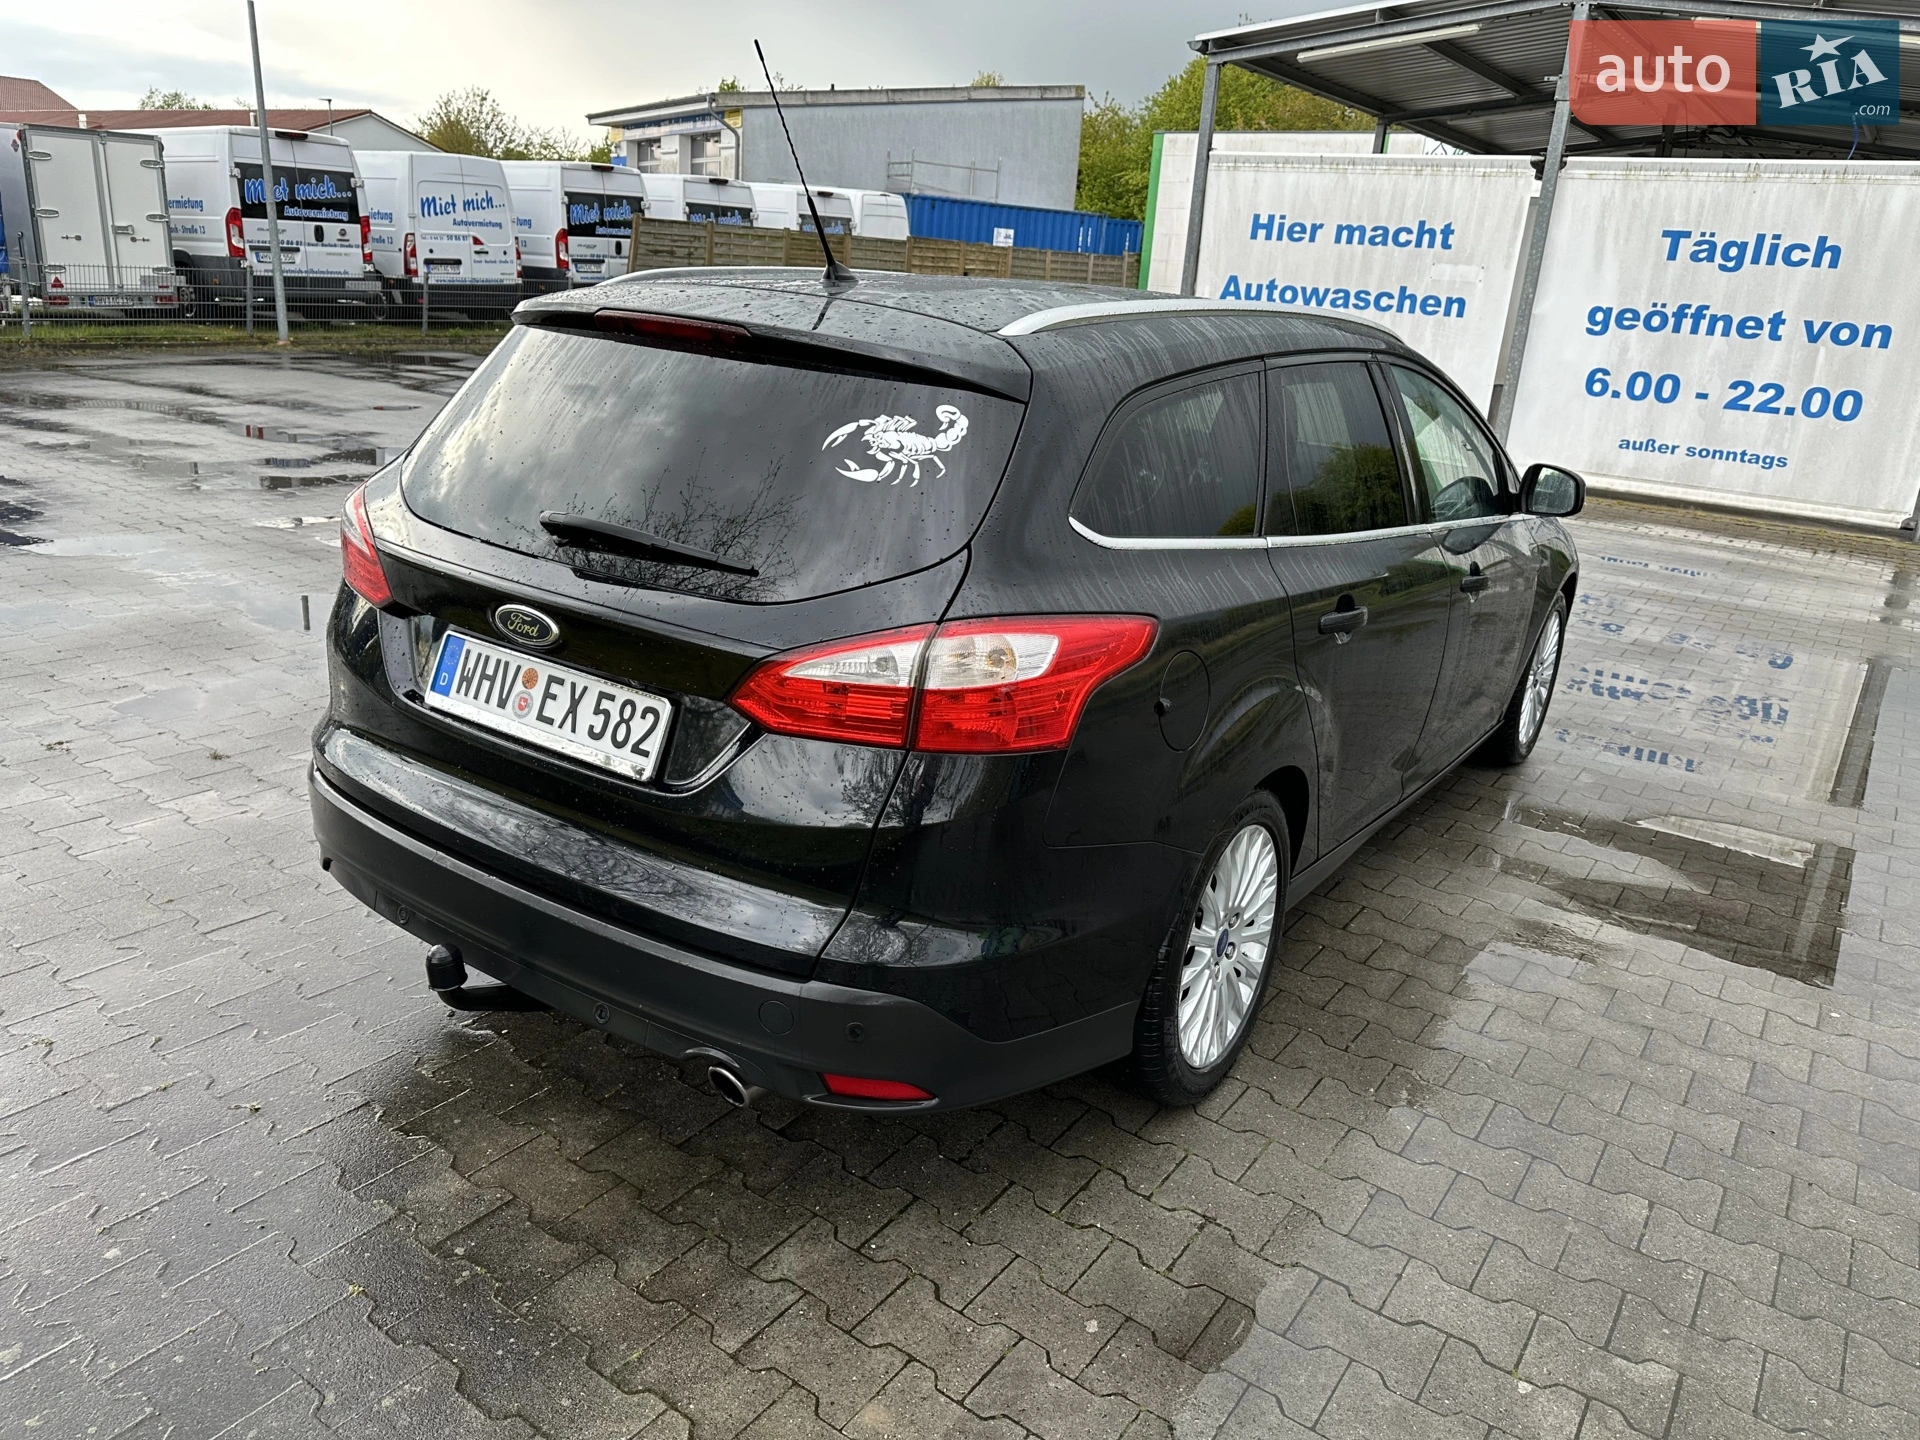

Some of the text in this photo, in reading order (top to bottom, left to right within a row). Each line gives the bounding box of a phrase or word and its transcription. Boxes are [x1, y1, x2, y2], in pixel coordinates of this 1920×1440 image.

[169, 194, 204, 212] ermietung
[245, 176, 289, 204] Met
[284, 205, 349, 221] Autovermietung
[369, 207, 393, 223] ietung
[420, 193, 457, 218] Miet
[570, 202, 600, 226] Miet
[452, 217, 503, 230] Autovermietung
[1250, 213, 1455, 250] Hier macht
[1661, 229, 1843, 273] Täglich
[1219, 275, 1467, 318] Autowaschen
[1585, 302, 1893, 350] geöffnet von
[1585, 367, 1863, 422] 6.00 - 22.00
[1618, 437, 1789, 471] außer sonntags
[507, 612, 540, 637] Ford
[439, 671, 449, 686] D
[455, 648, 522, 710] WHV
[535, 674, 589, 734] EX
[587, 690, 661, 758] 582
